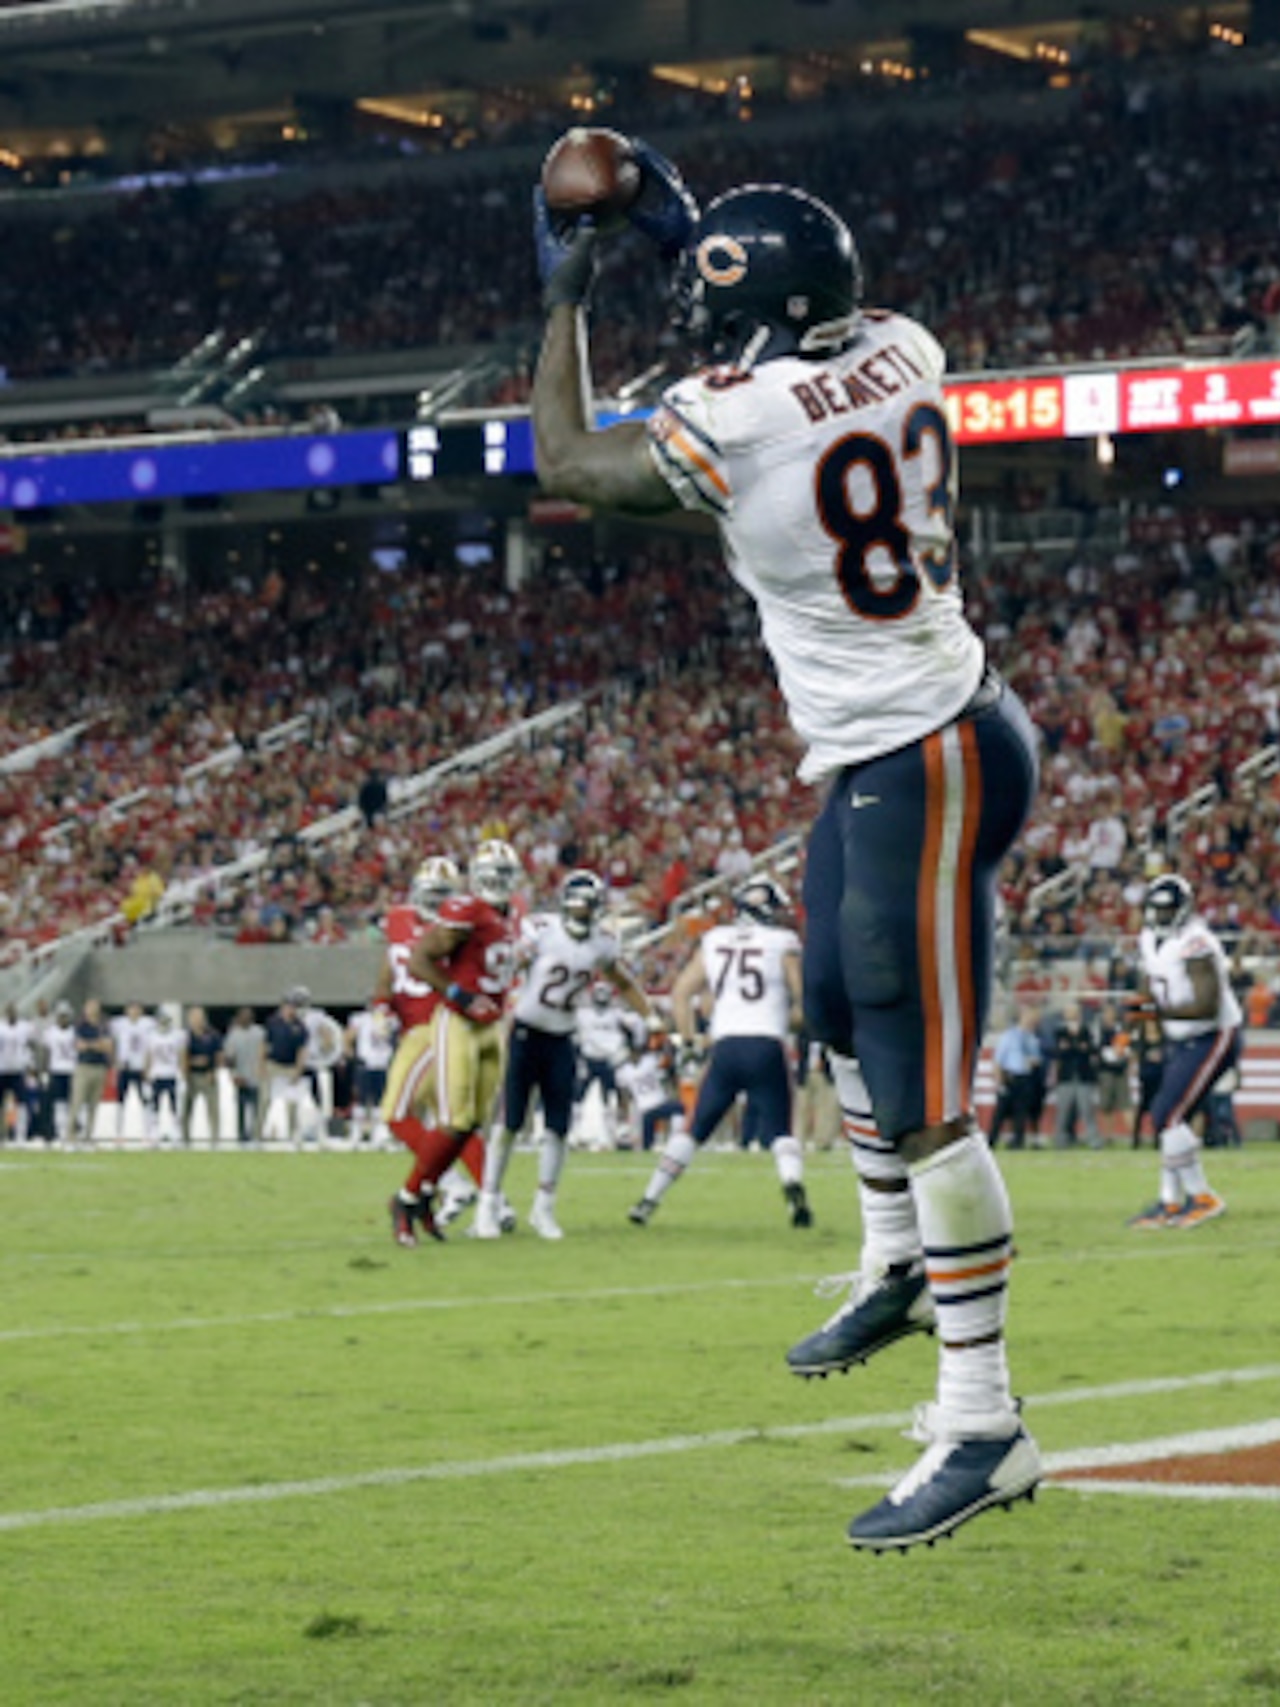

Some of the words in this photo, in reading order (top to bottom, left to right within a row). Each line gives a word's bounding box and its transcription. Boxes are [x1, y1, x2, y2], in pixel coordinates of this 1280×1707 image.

[814, 402, 954, 622] 83
[538, 965, 593, 1011] 22
[715, 948, 765, 1002] 75
